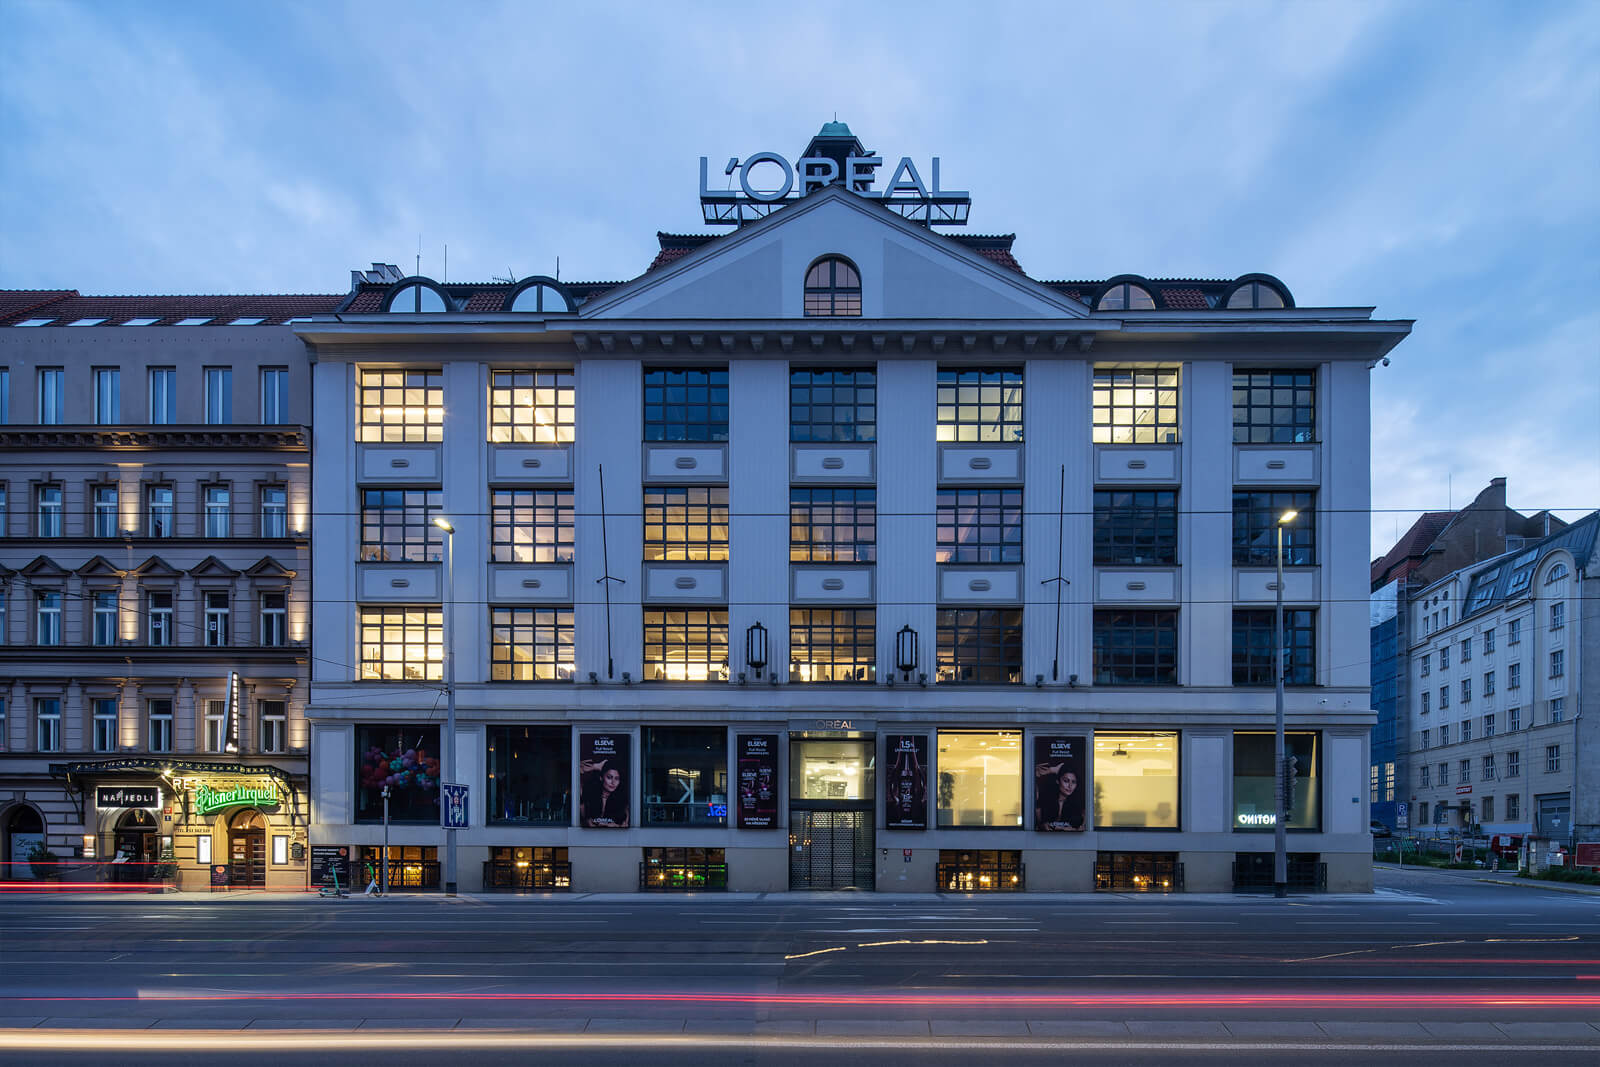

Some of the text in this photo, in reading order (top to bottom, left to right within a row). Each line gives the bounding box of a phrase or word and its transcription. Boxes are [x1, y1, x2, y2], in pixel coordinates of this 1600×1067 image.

[700, 151, 969, 200] L'ORÉAL
[196, 784, 277, 815] Pilsner Urquell
